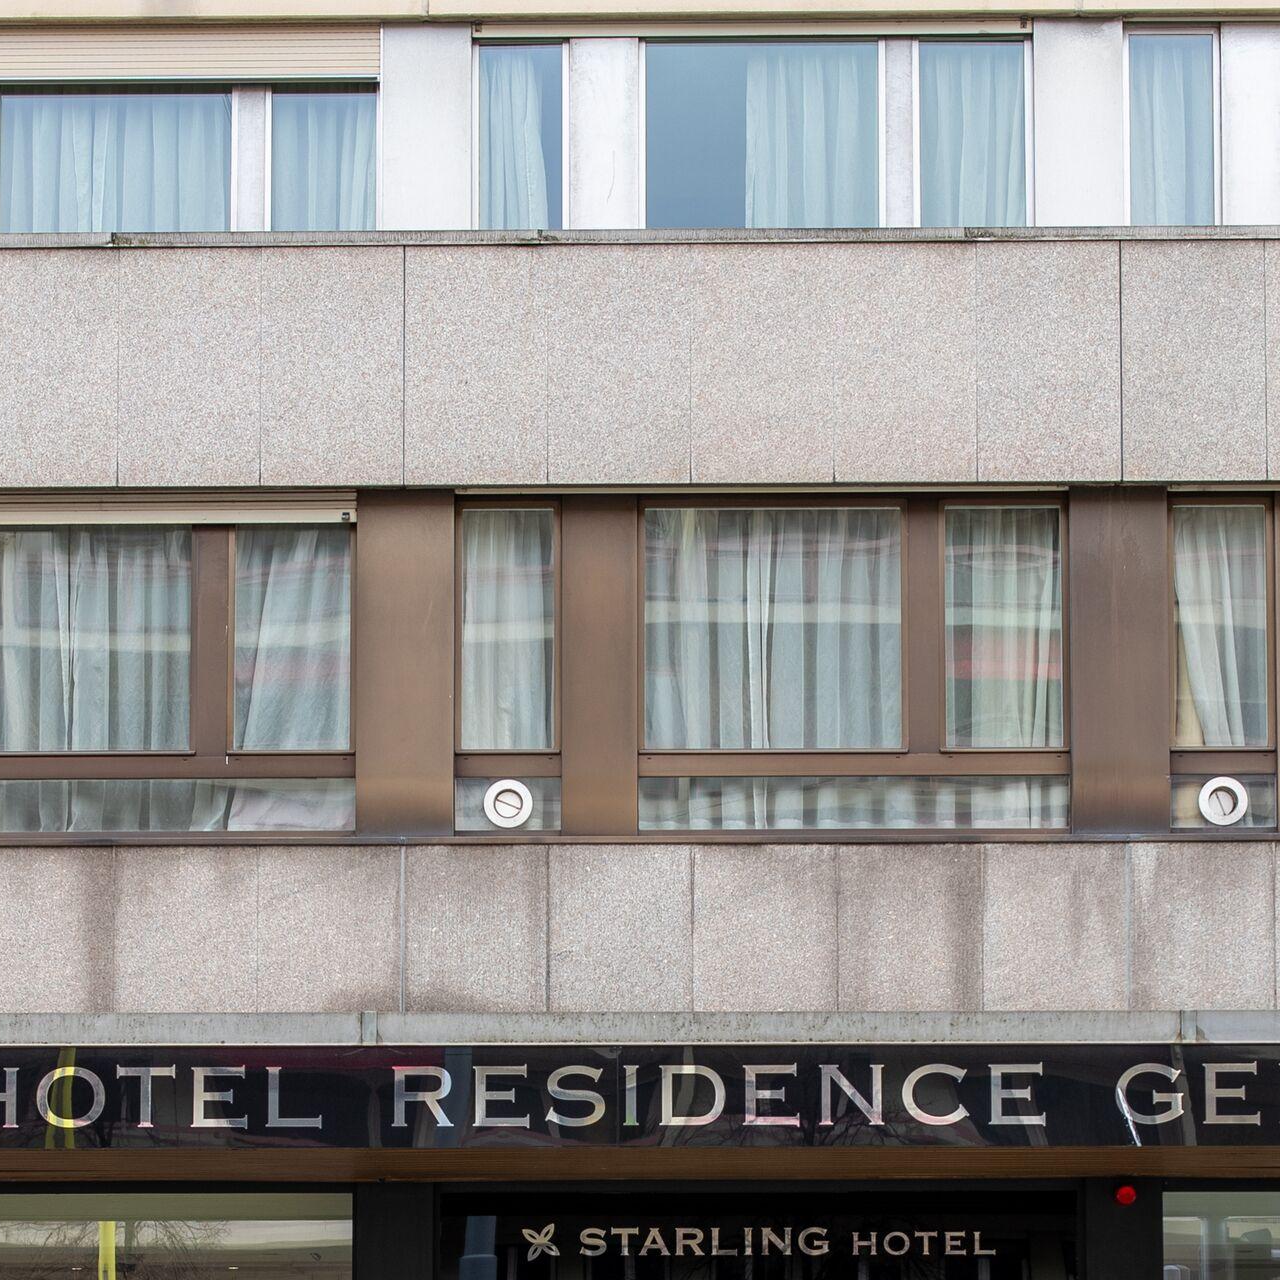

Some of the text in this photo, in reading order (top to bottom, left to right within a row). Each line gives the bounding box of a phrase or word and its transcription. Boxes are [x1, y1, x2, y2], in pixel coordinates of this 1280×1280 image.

[390, 1061, 1048, 1129] RESIDENCE
[578, 1226, 997, 1257] STARLING HOTEL
